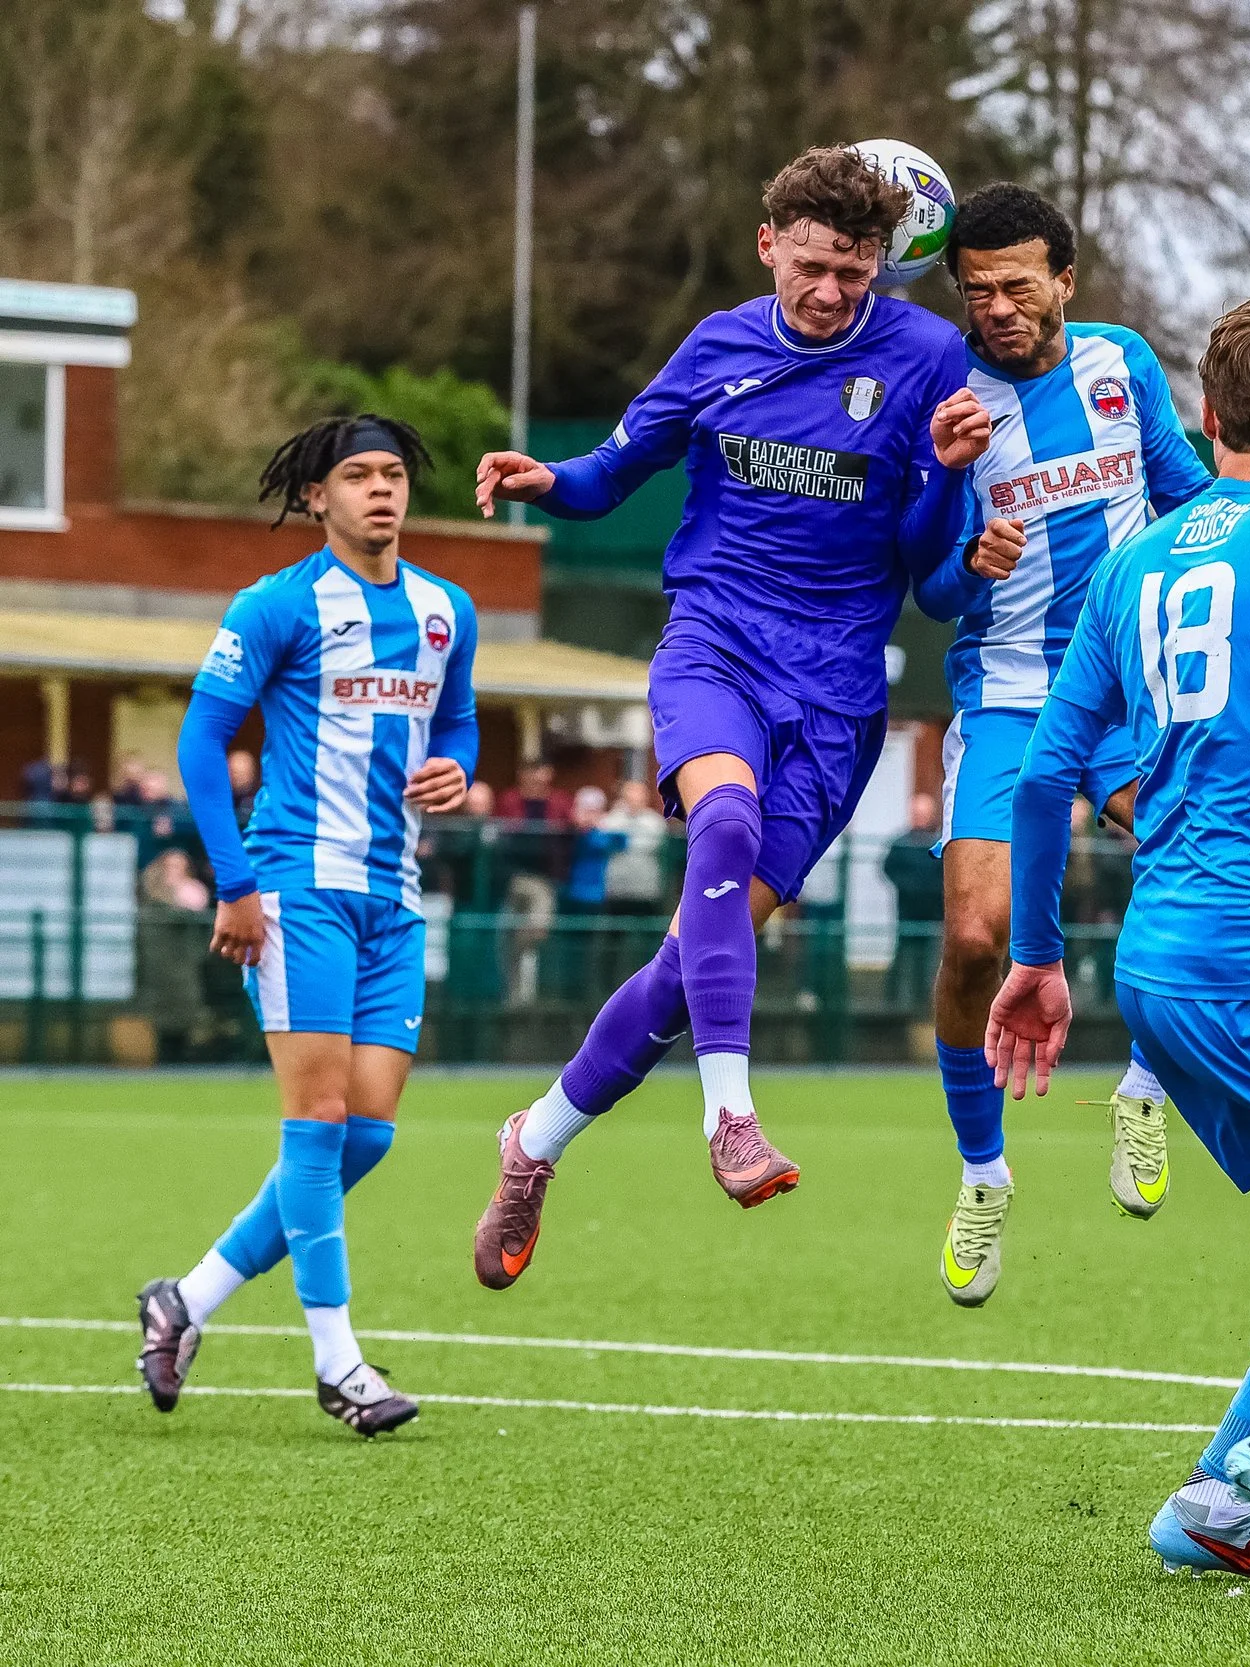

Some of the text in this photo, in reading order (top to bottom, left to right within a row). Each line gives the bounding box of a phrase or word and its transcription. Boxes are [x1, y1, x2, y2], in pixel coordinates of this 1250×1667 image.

[750, 440, 836, 474] BATCHELOR
[750, 465, 864, 501] CONSTRUCTION
[988, 450, 1136, 509] STUART
[1000, 476, 1134, 516] PLUMBING & HEATING SUPPLIES
[1175, 512, 1243, 544] TOUCH
[1138, 560, 1236, 729] 18
